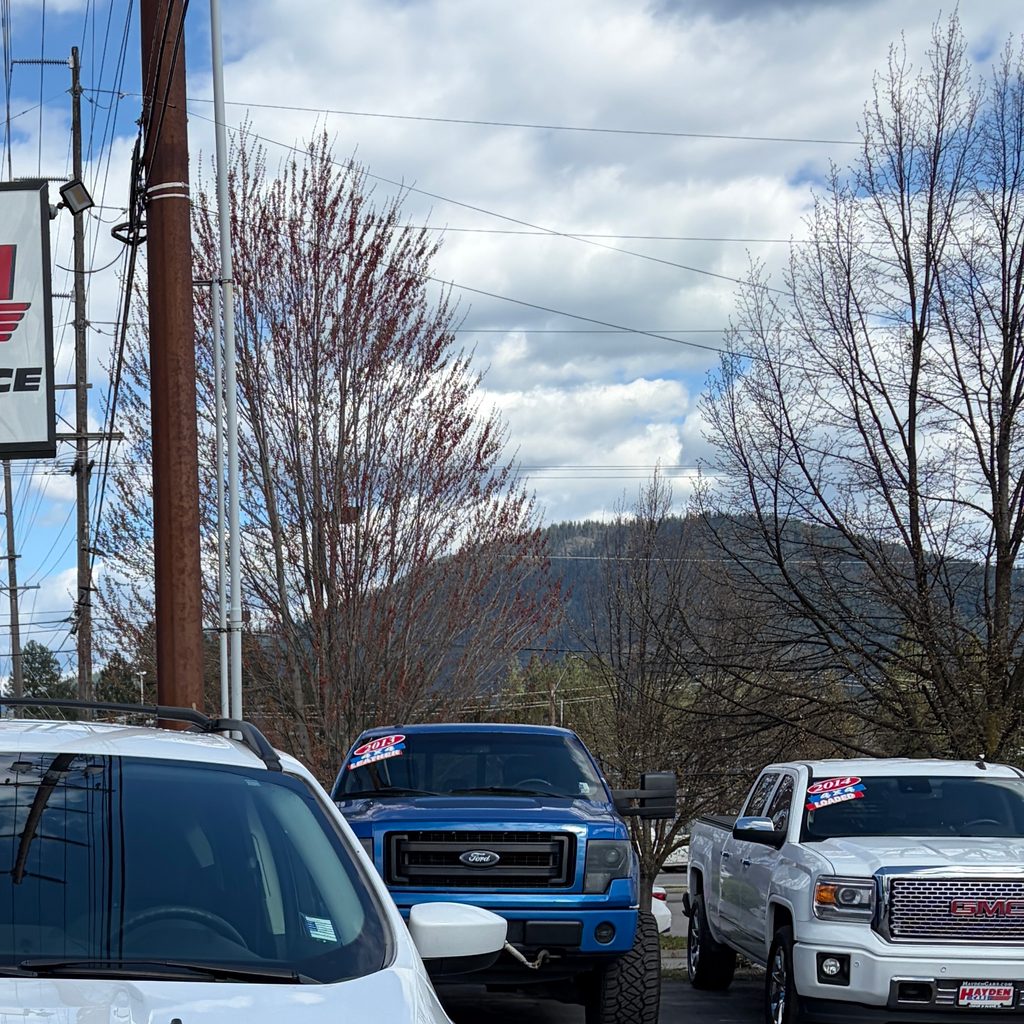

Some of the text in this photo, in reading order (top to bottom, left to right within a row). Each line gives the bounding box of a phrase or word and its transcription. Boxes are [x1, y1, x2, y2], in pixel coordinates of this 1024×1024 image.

[366, 736, 395, 751] 2013
[814, 777, 852, 792] 2014
[814, 793, 856, 809] LOADED
[468, 852, 491, 862] Ford
[950, 899, 1024, 917] GMC
[960, 988, 1012, 1001] HAYDEN
